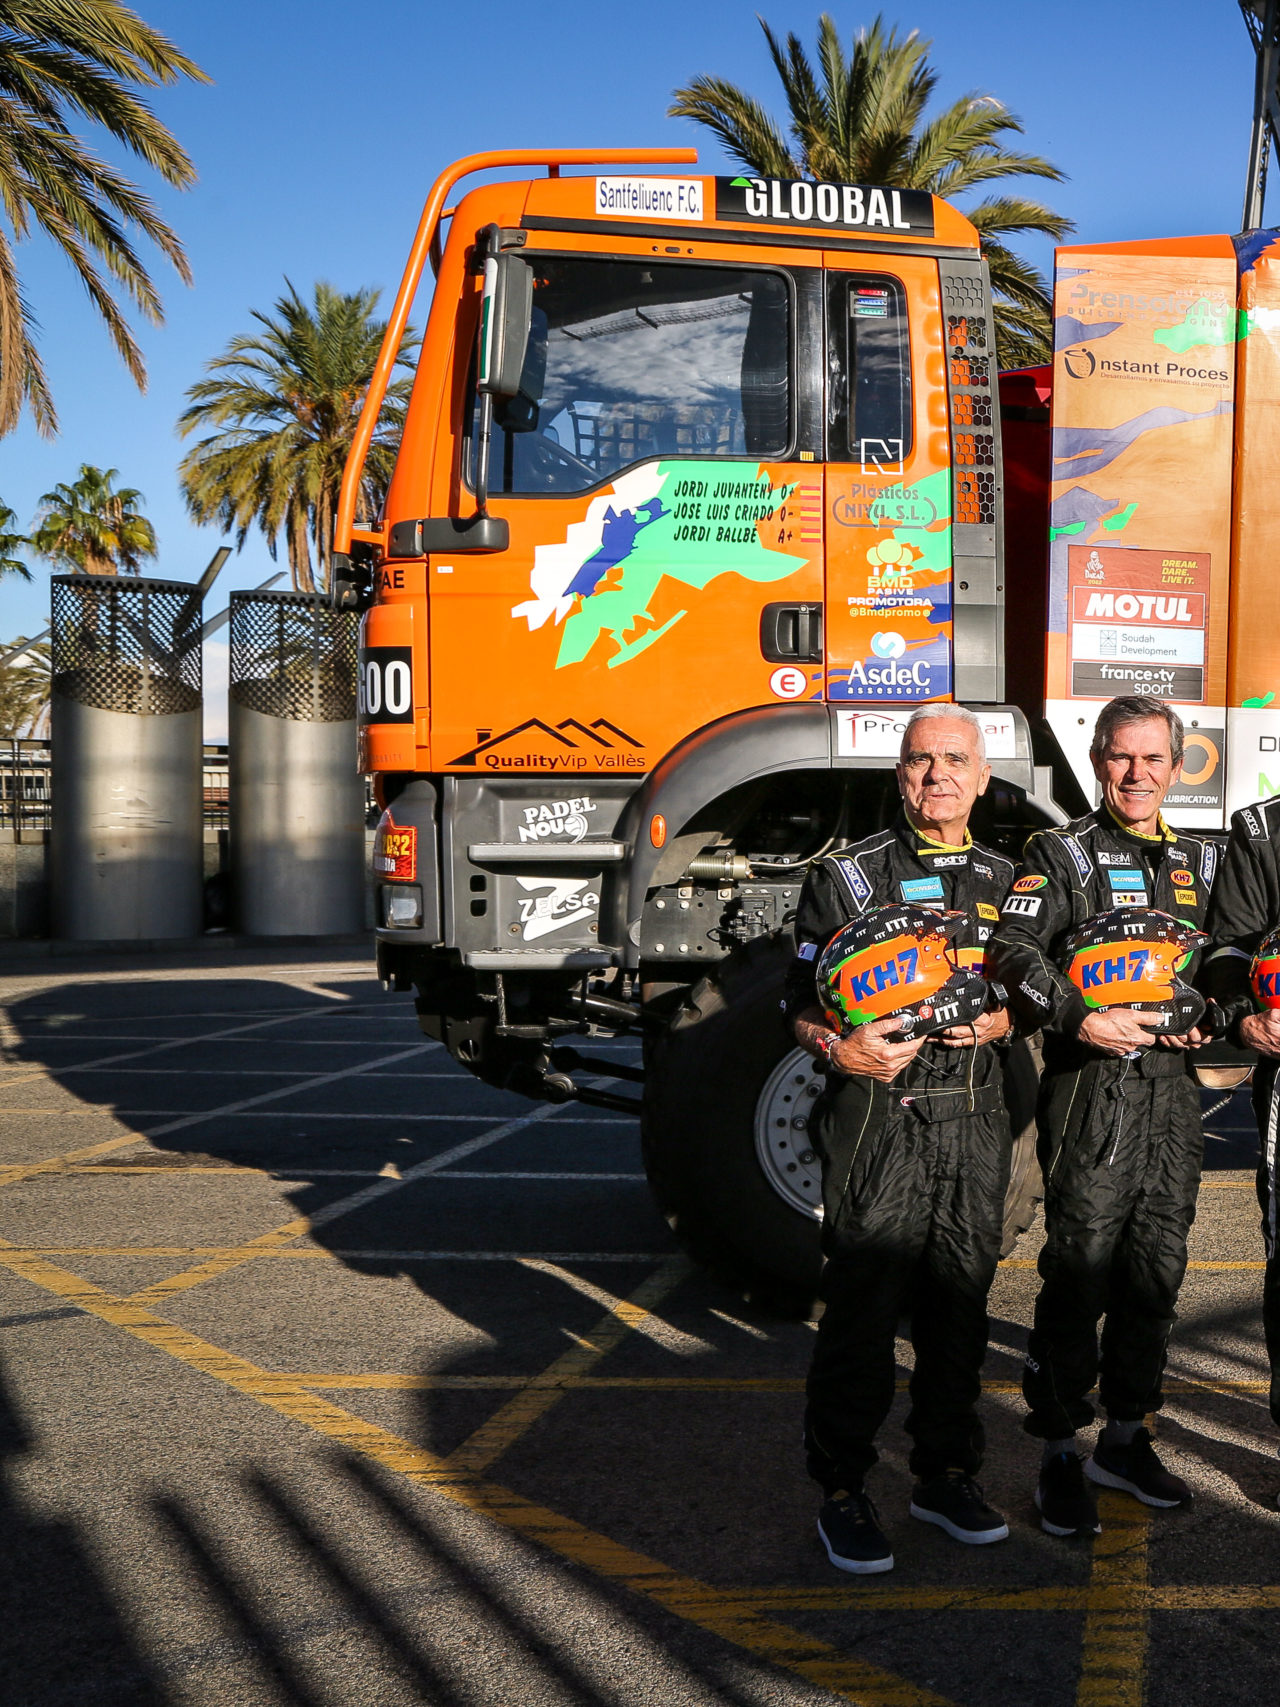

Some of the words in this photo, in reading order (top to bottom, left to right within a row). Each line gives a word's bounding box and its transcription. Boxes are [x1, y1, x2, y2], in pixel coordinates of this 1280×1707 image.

[599, 181, 673, 213] Santfeliuenc
[678, 185, 700, 214] F.C.
[744, 179, 910, 229] GLOOBAL
[1166, 362, 1229, 381] Proces
[674, 480, 709, 499] JORDI
[712, 481, 775, 501] JUVANTENY
[706, 504, 730, 520] LUIS
[734, 504, 775, 522] CRIADO
[895, 504, 927, 521] S.L.
[673, 524, 711, 543] JORDI
[777, 527, 794, 545] A+
[1161, 559, 1199, 570] DREAM.
[1161, 567, 1190, 577] DARE.
[867, 576, 914, 588] BMD
[1161, 576, 1183, 585] LIVE
[867, 588, 914, 596] PASIVE
[847, 597, 933, 607] PROMOTORA
[1085, 592, 1193, 622] MOTUL
[1121, 633, 1155, 645] Soudah
[1120, 645, 1178, 658] Development
[847, 660, 931, 687] AsdeC
[847, 687, 931, 695] assessors
[1134, 682, 1174, 697] sport
[595, 753, 645, 767] Vallès
[1163, 794, 1218, 805] LUBRICATION
[523, 797, 597, 824] PADEL
[518, 821, 565, 842] NOU
[518, 891, 600, 923] ZELSA
[885, 916, 909, 933] ITT
[1124, 923, 1146, 935] ITT
[935, 1001, 960, 1024] ITT
